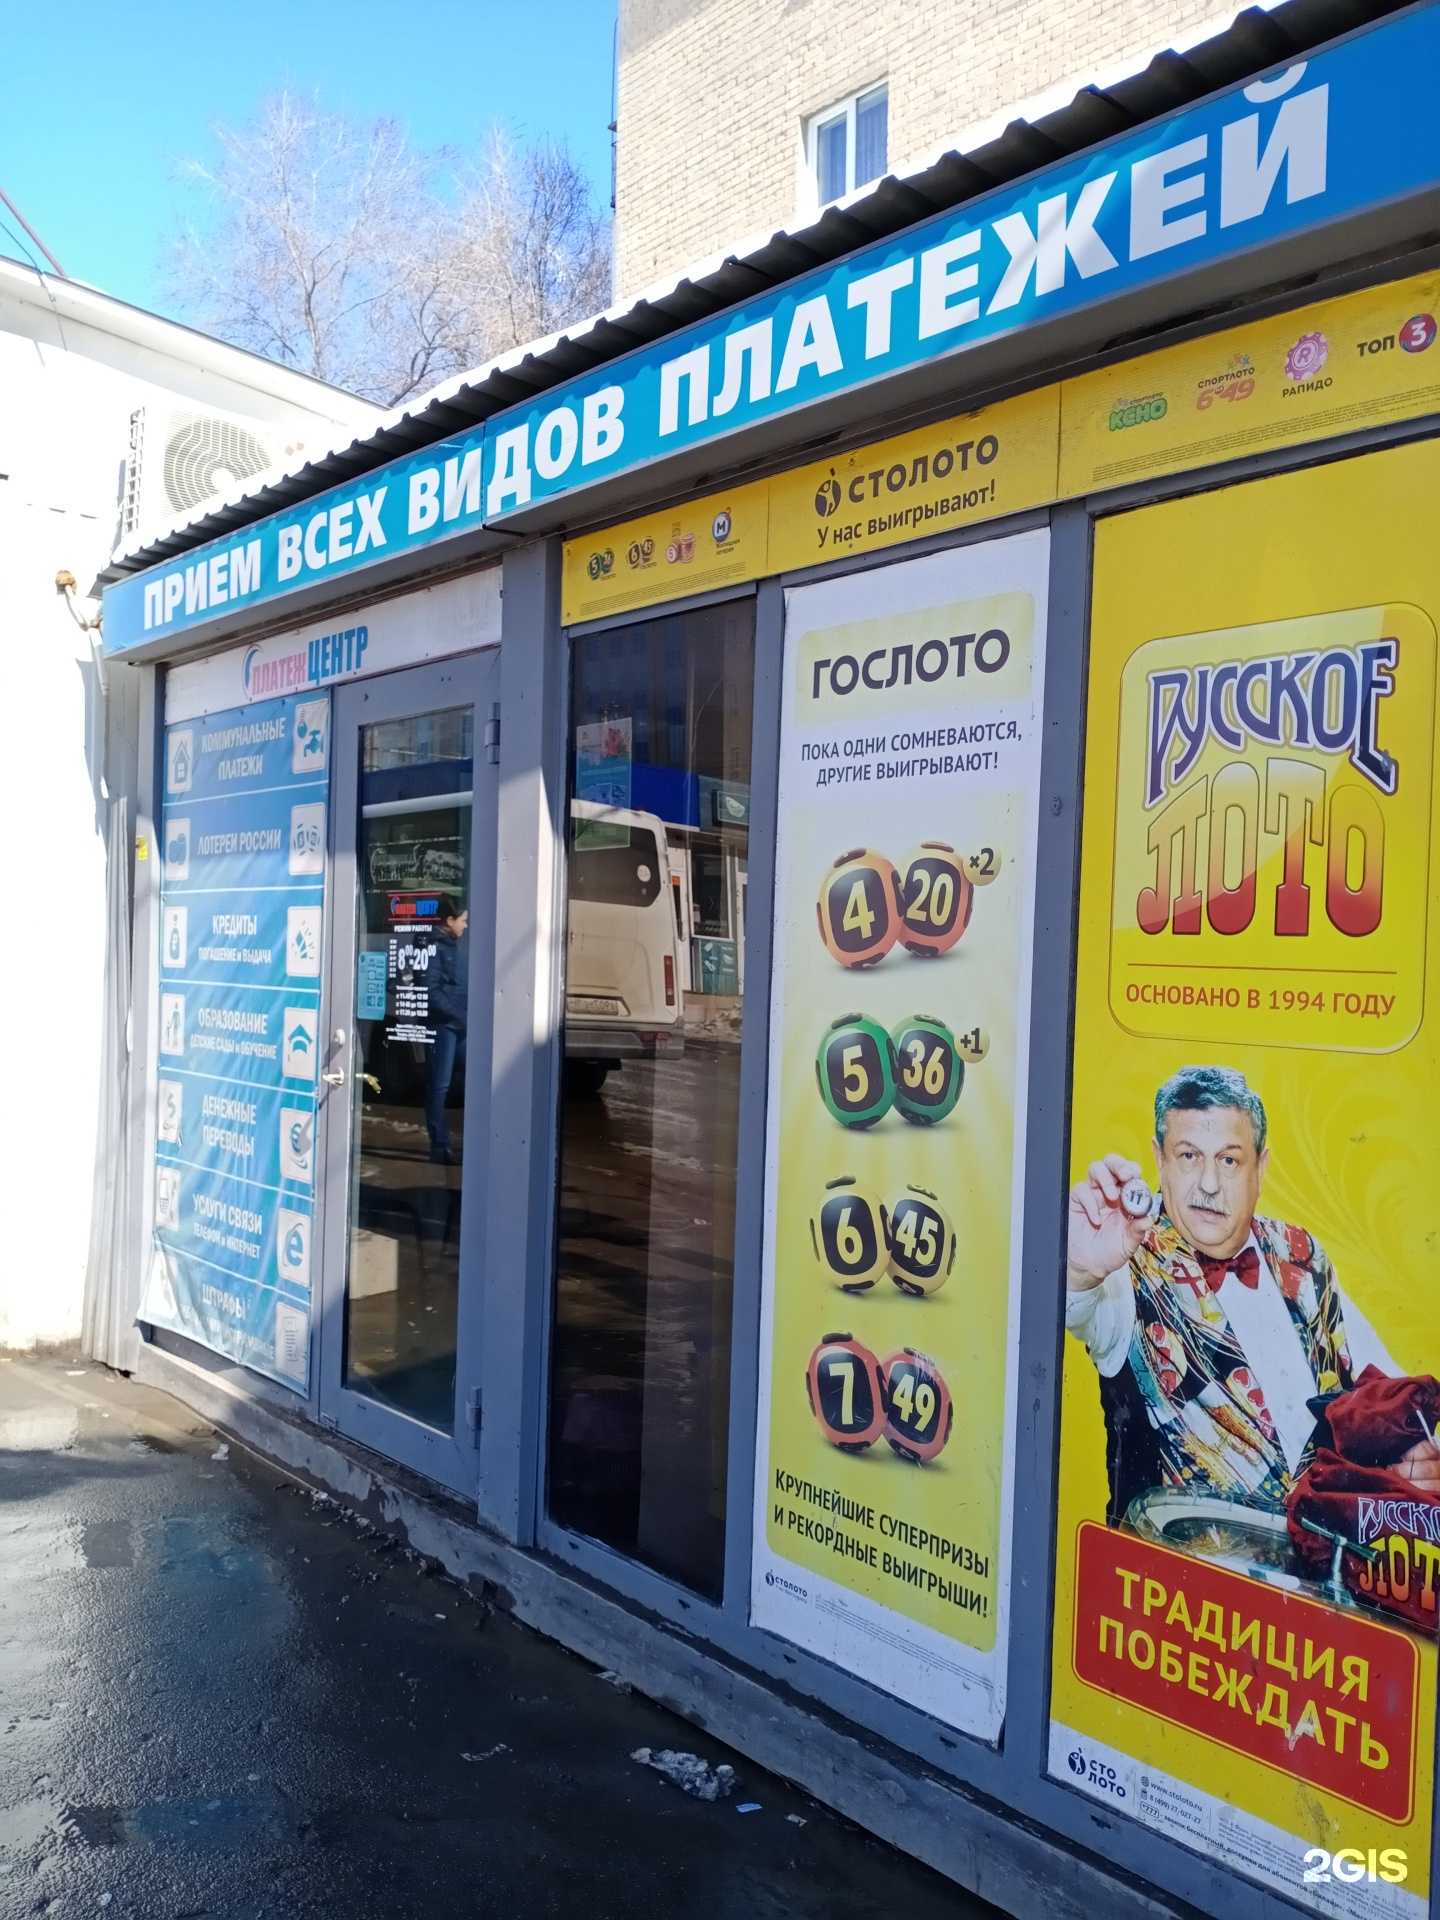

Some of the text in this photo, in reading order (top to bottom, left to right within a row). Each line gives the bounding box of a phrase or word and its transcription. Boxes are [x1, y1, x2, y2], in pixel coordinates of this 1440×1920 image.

[143, 61, 1330, 630] ПРИЕМ ВСЕХ ВИДОВ ПЛАТЕЖЕЙ
[1296, 347, 1311, 363] R
[1357, 321, 1426, 357] ТОП 3
[1197, 367, 1256, 388] СПОРТЛОТО
[1282, 377, 1333, 398] РАПИДО
[1109, 398, 1168, 432] КЕНО
[849, 434, 1000, 504] СТОЛОТО
[816, 478, 996, 548] У нас выигрывают!
[251, 625, 369, 696] ПЛАТЕЖЦЕНТР
[812, 629, 1011, 699] ГОСЛОТО
[201, 716, 288, 753] КОММУНАЛЬНЫЕ
[801, 720, 1023, 761] ПОКА ОДНИ СОМНЕВАЮТСЯ,
[1143, 638, 1400, 810] РУССКОЕ
[217, 754, 264, 781] ПЛАТЕЖИ
[816, 751, 999, 787] ДРУГИЕ ВЫИГРЫВАЮТ!
[197, 829, 283, 856] ЛОТЕРЕИ РОССИИ
[1136, 757, 1386, 938] ЛОТО
[842, 878, 875, 940] 4
[906, 868, 954, 927] 20
[212, 914, 258, 939] КРЕДИТЫ
[242, 949, 273, 965] ВЫДАЧА
[1125, 983, 1396, 1019] ОСНОВАНО В 1994 ГОДУ
[198, 1008, 269, 1034] ОБРАЗОВАНИЕ
[842, 1027, 983, 1103] 5 36 +1
[202, 1095, 257, 1125] ДЕНЕЖНЫЕ
[203, 1125, 255, 1157] ПЕРЕВОДЫ
[192, 1194, 263, 1235] УСЛУГИ СВЯЗИ
[836, 1207, 939, 1266] 6 45
[202, 1284, 246, 1320] ШТРАФЫ
[828, 1361, 936, 1433] 7 49
[775, 1468, 989, 1579] КРУПНЕЙШИЕ СУПЕРПРИЗЫ
[774, 1504, 988, 1618] И РЕКОРДНЫЕ ВЫИГРЫШИ!
[775, 1576, 808, 1598] СТОЛОТО
[1115, 1566, 1369, 1702] ТРАДИЦИЯ
[1098, 1615, 1390, 1771] ПОБЕЖДАТЬ
[1087, 1772, 1126, 1798] ЛОТО
[1089, 1759, 1117, 1780] СТО
[1150, 1782, 1203, 1812] www.stoloto.ru
